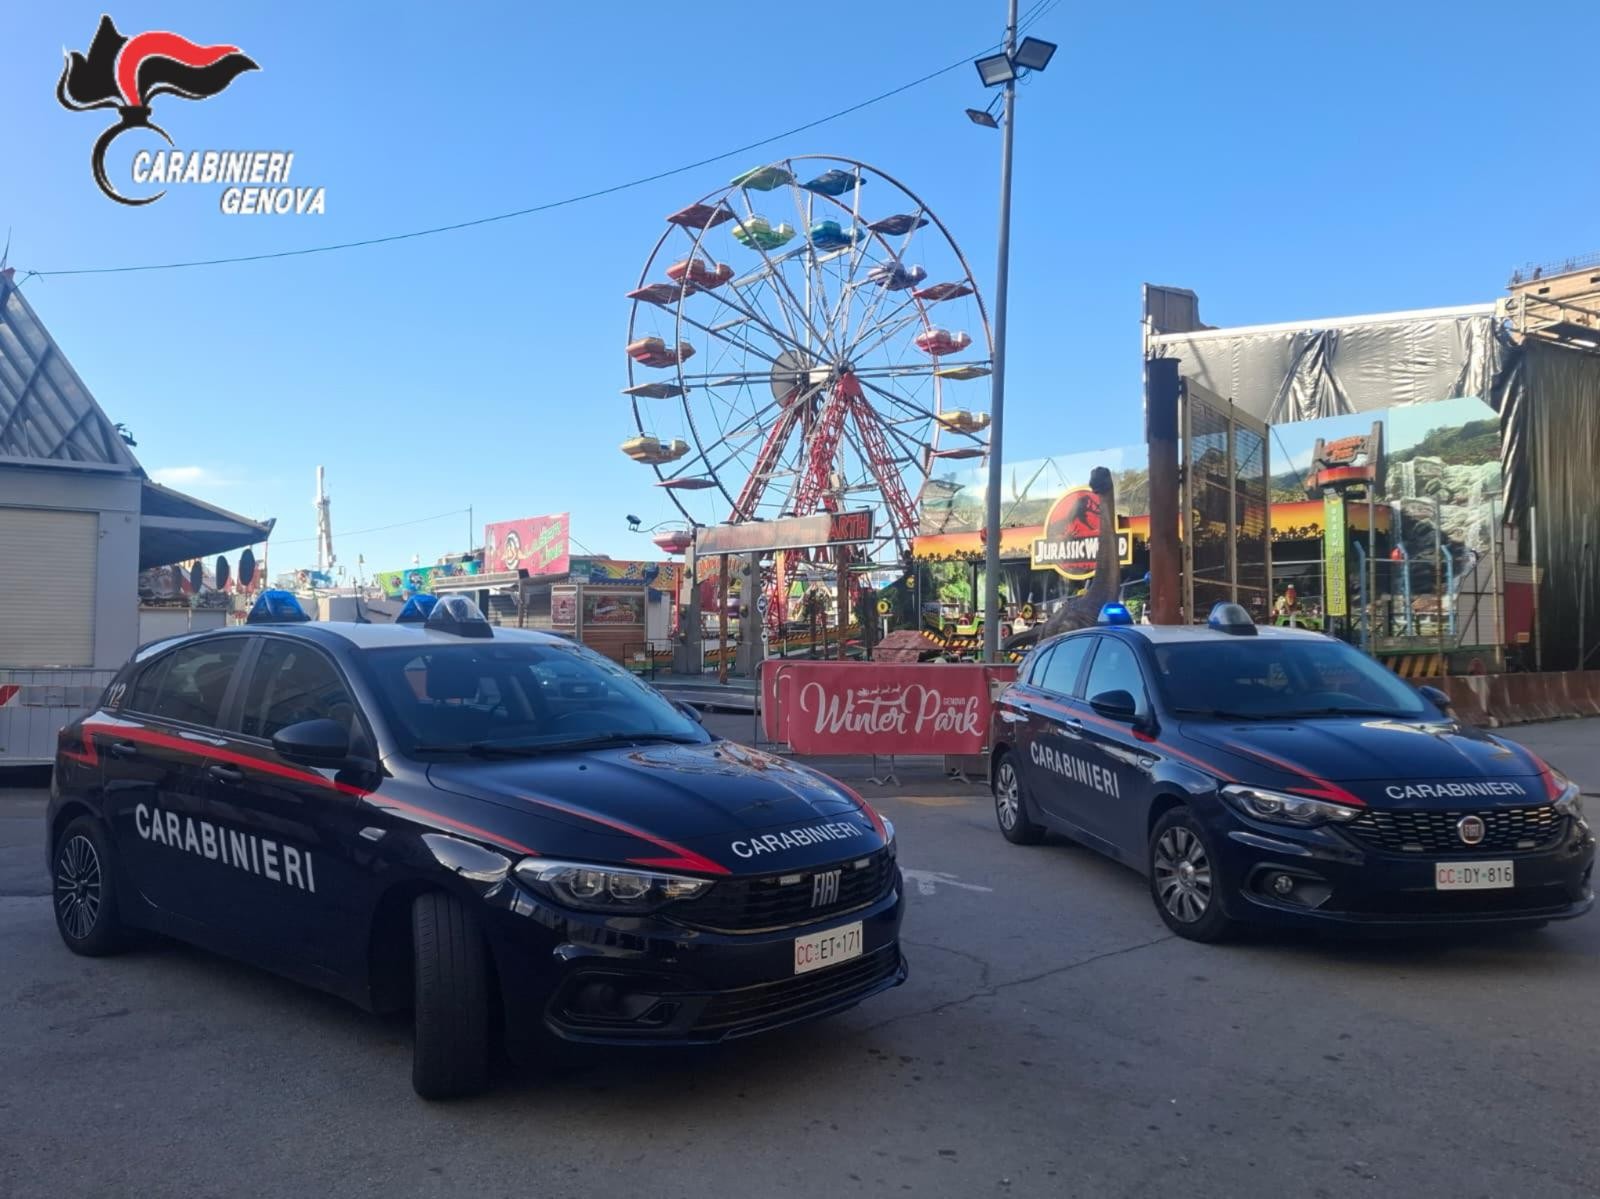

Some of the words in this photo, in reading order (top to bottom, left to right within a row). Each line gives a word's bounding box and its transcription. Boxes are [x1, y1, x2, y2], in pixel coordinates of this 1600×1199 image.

[800, 682, 907, 734] Winter
[900, 684, 983, 737] Park
[1030, 741, 1120, 799] CARABINIERI
[1385, 782, 1527, 799] CARABINIERI
[135, 803, 316, 893] CARABINIERI
[731, 822, 864, 858] CARABINIERI
[811, 869, 843, 909] FIAT
